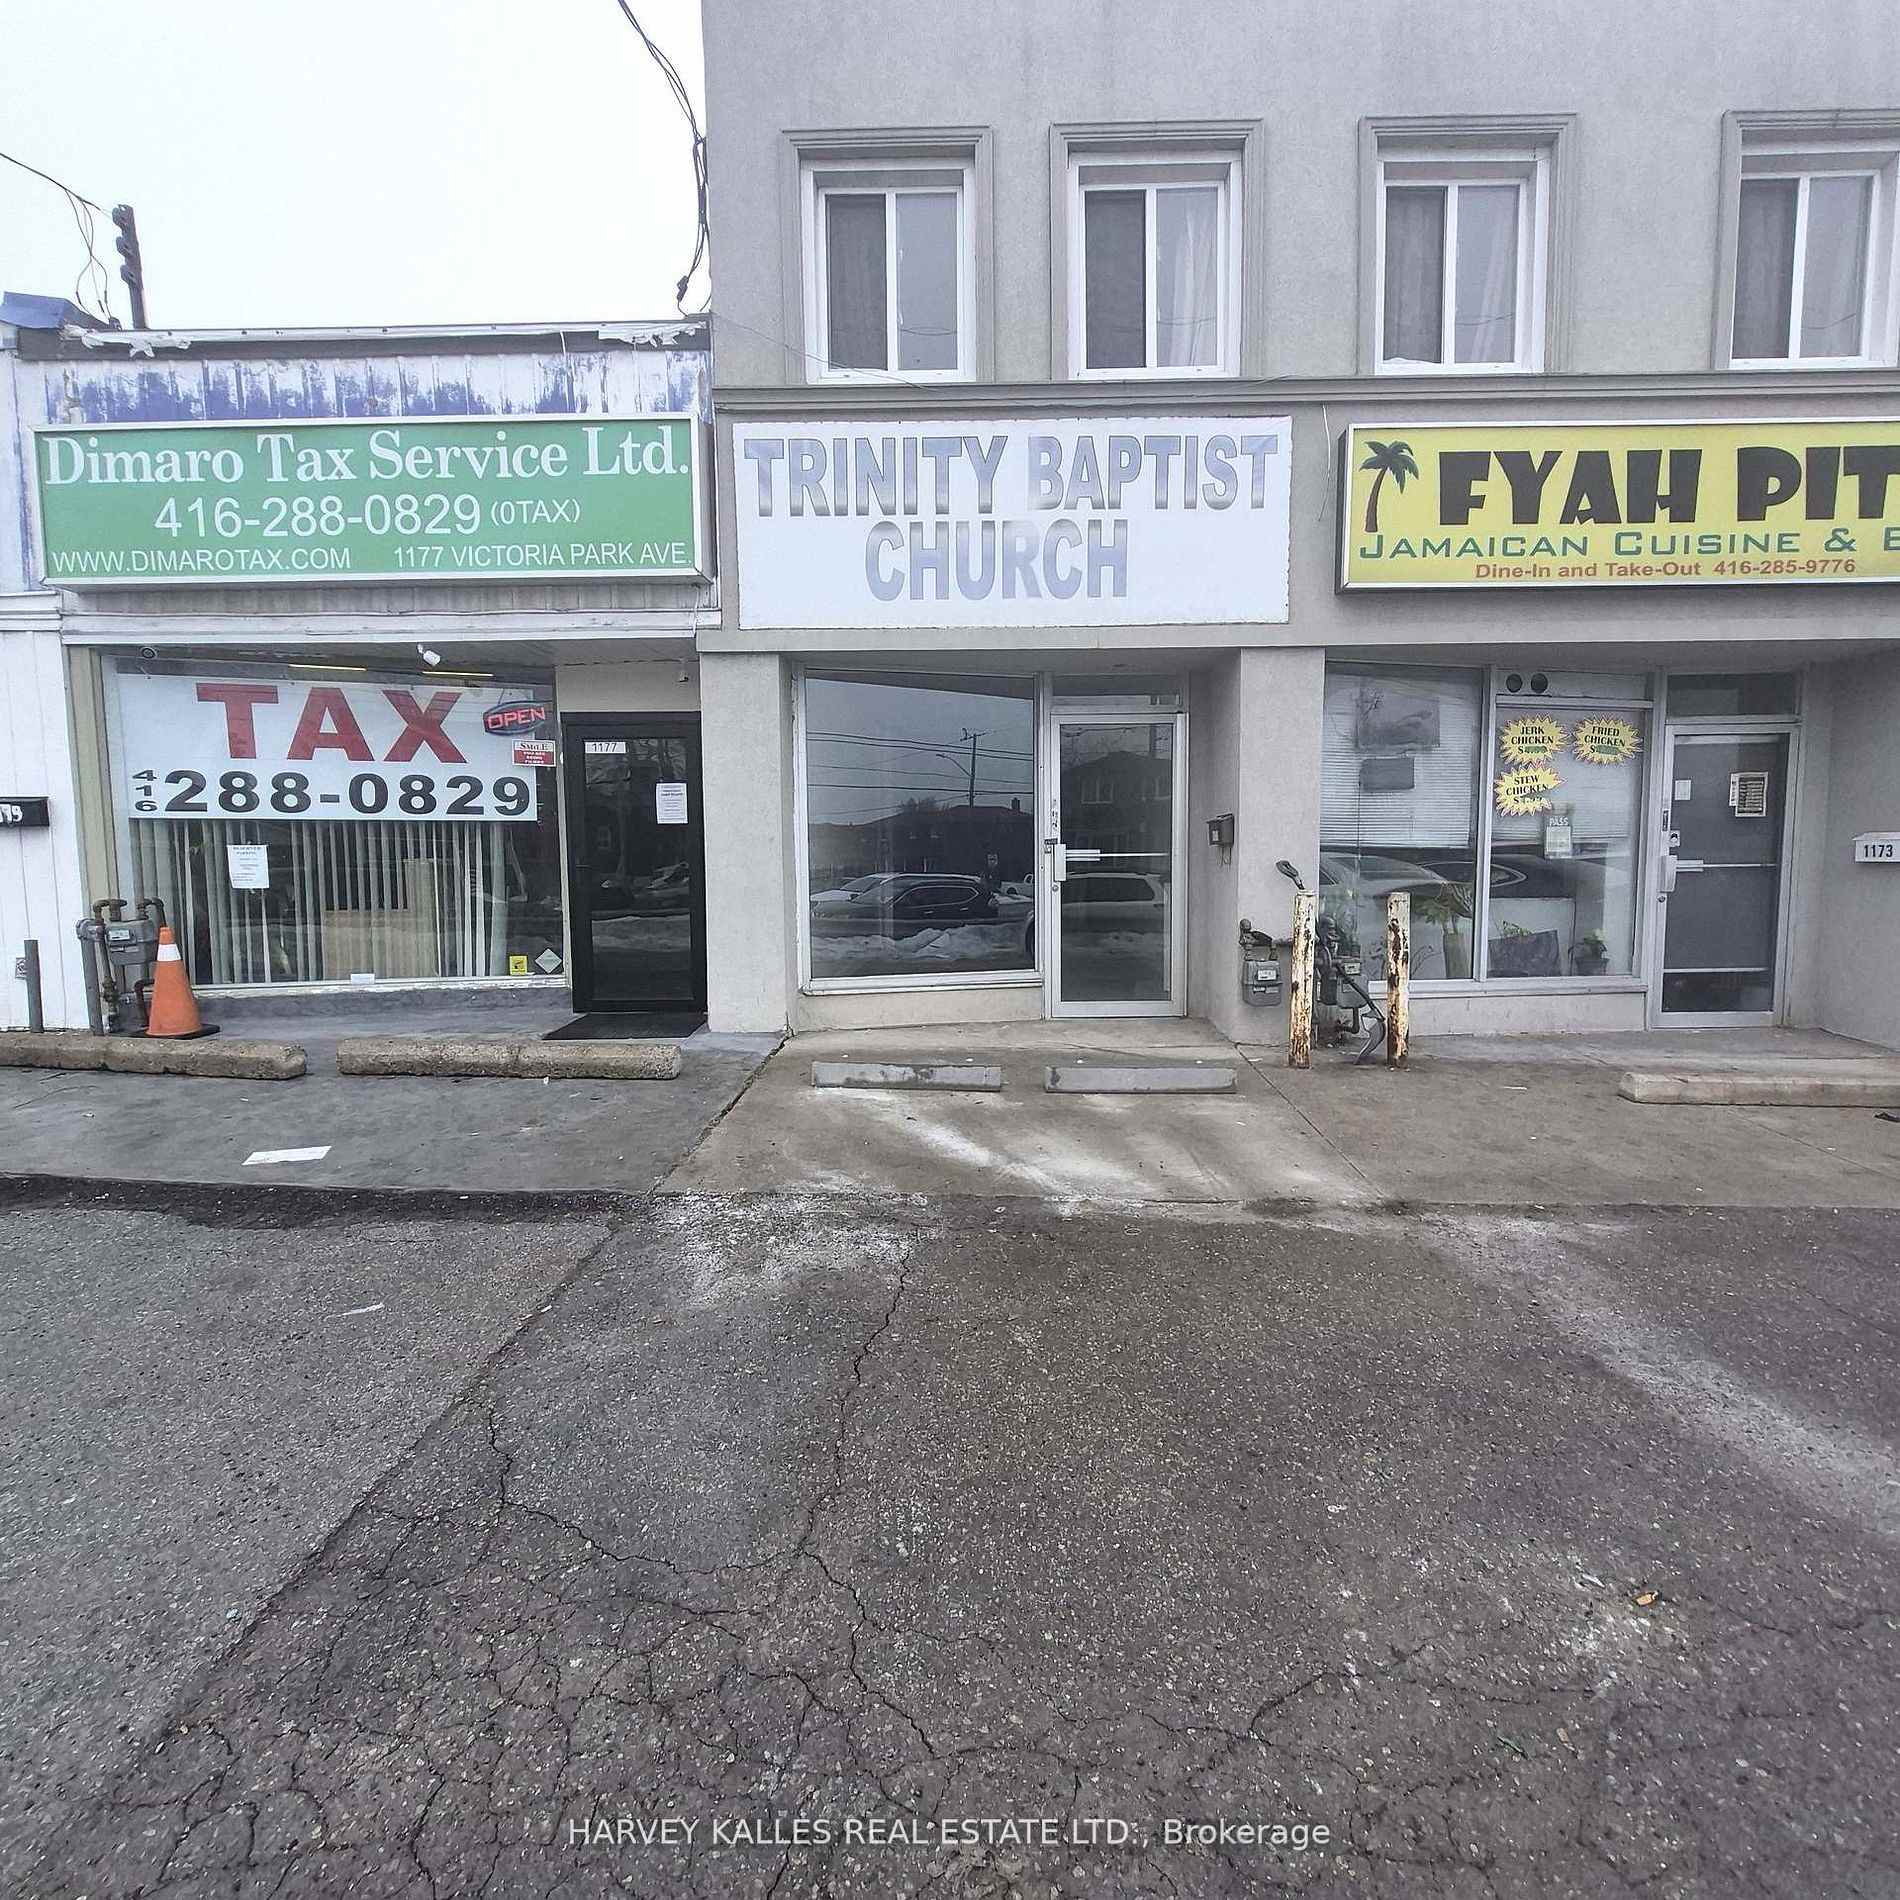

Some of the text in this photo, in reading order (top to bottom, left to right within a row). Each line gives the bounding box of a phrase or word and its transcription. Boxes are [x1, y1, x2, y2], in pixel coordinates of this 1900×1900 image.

[43, 425, 689, 484] Dimaro Tax Service Ltd.
[744, 434, 1279, 517] TRINITY BAPTIST
[1438, 445, 1900, 525] FYAH PIT
[155, 494, 480, 538] 416-288-0829
[1824, 527, 1857, 552] &
[53, 541, 693, 573] WWW.DIMAROTAX.COM 1177 VICTORIA PARK AVE.
[864, 519, 1128, 601] CHURCH
[1475, 558, 1857, 579] Dine-In and Take-Out 416-285-9776
[195, 682, 468, 764] TAX
[487, 706, 546, 729] OPEN
[1511, 736, 1553, 745] CHICKEN
[1520, 726, 1545, 735] JERK
[1584, 735, 1625, 747] CHICKEN
[1592, 726, 1620, 736] FRIED
[592, 742, 617, 752] 1177
[1505, 784, 1547, 796] CHICKEN
[1514, 775, 1539, 785] STEW
[164, 769, 530, 817] 288-0829
[1864, 844, 1893, 858] 1173
